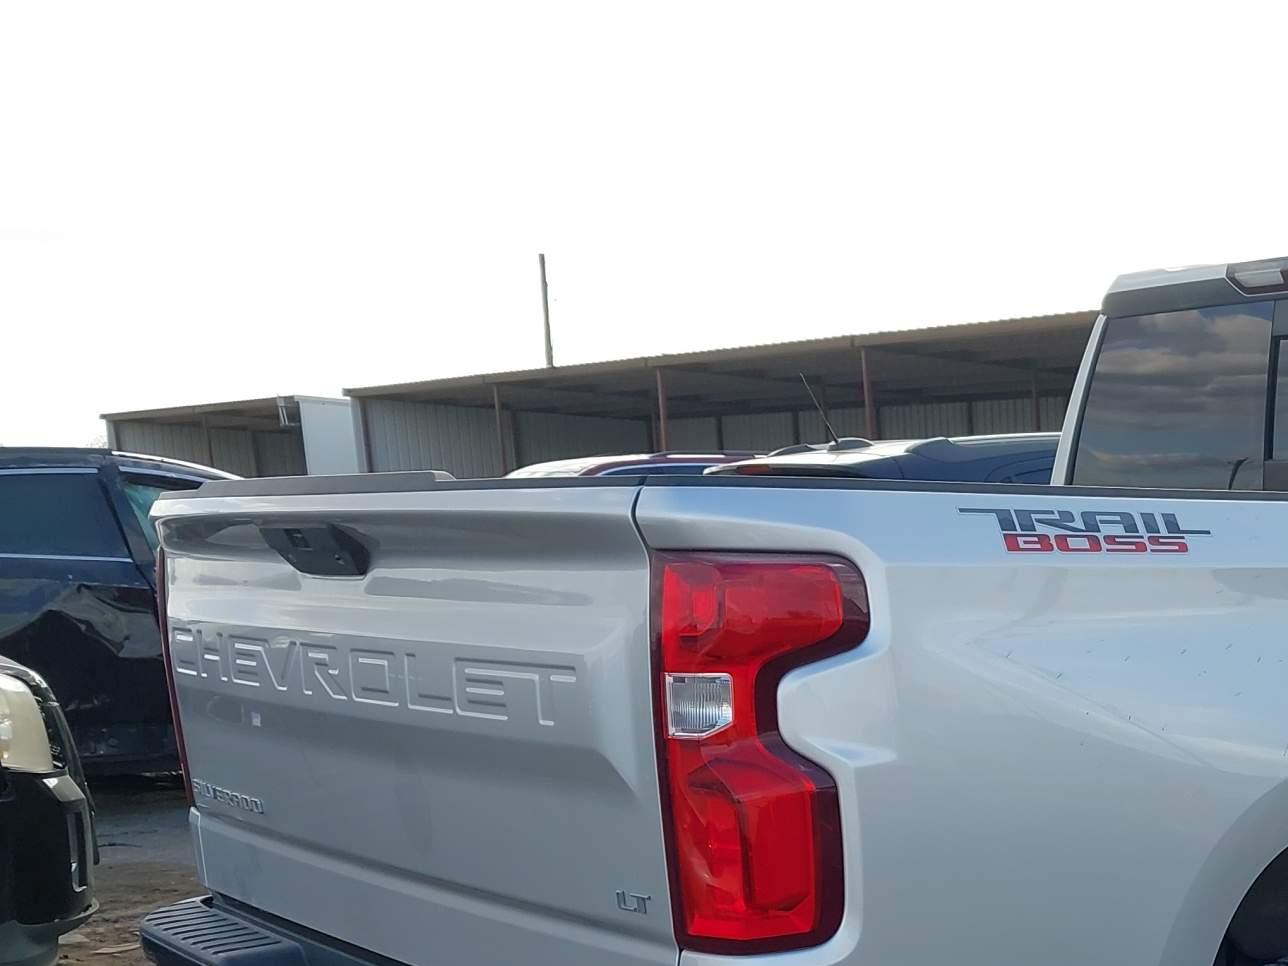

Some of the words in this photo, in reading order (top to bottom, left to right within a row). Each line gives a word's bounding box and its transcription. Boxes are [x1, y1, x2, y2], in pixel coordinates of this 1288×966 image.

[958, 507, 1211, 535] TRAIL
[1002, 533, 1189, 553] BOSS
[172, 627, 577, 727] CHEVROLET
[616, 889, 652, 914] LT
